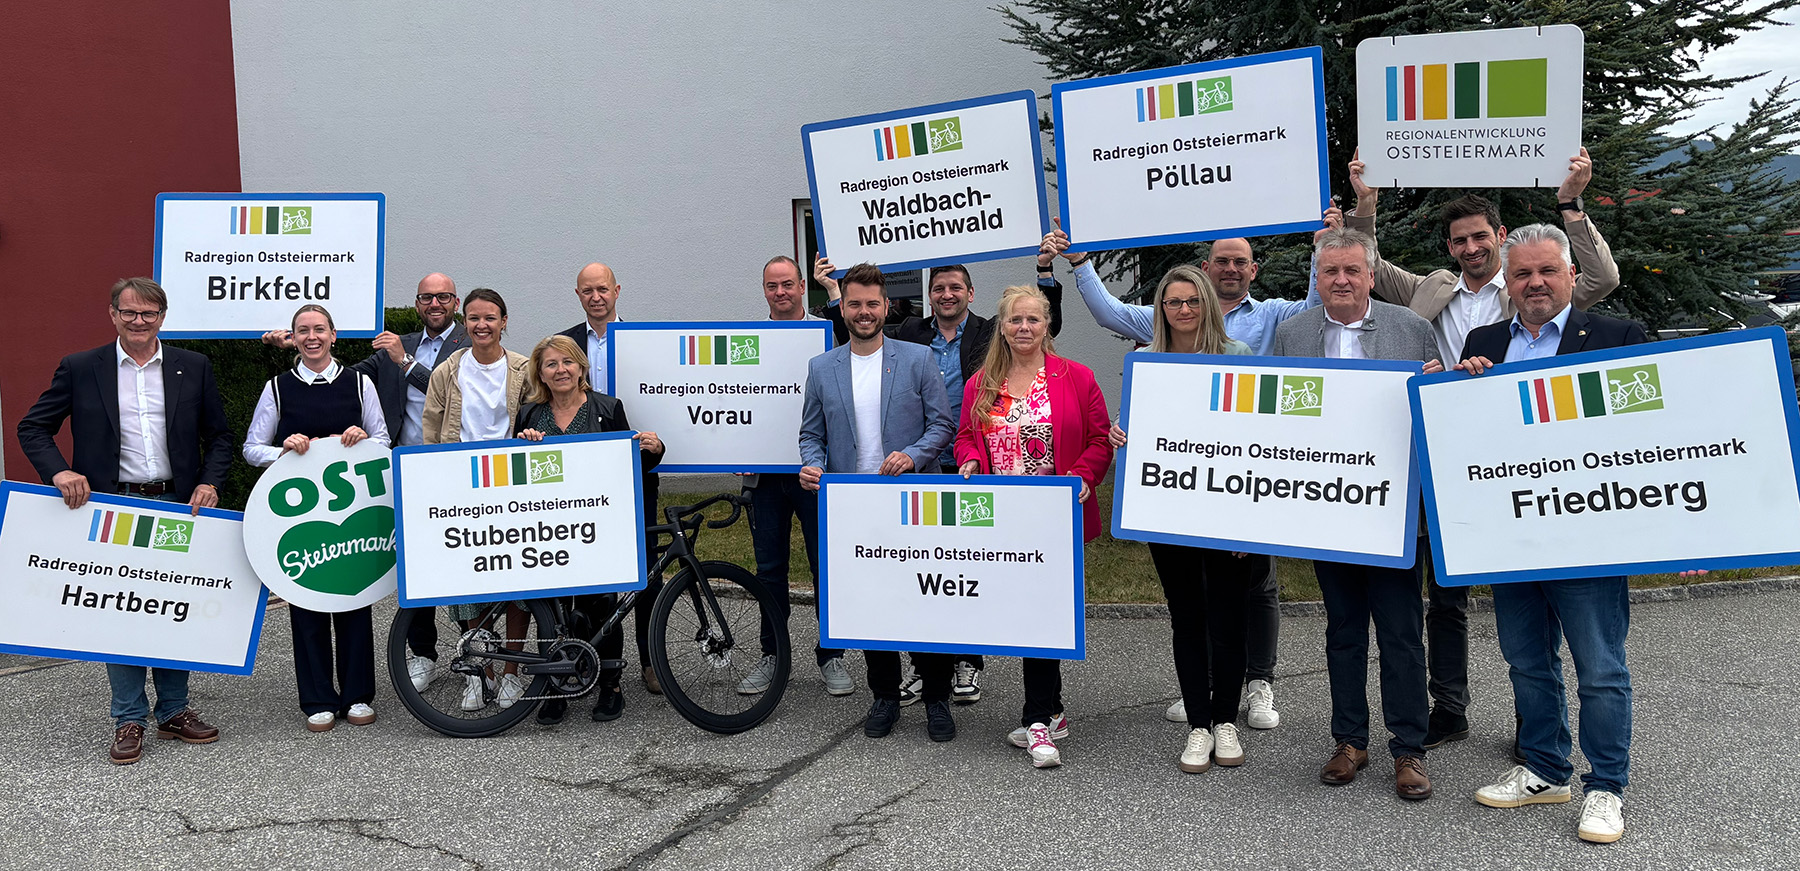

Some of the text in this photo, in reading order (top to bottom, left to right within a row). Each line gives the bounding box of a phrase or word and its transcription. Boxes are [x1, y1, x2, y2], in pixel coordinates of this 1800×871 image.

[1093, 126, 1286, 161] Radregion Oststeiermark
[1387, 127, 1545, 140] REGIONALENTWICKLUNG
[1387, 144, 1544, 159] OSTSTEIERMARK
[840, 160, 1009, 194] Radregion Oststeiermark
[1147, 164, 1231, 190] Pöllau
[862, 186, 991, 220] Waldbach-
[858, 207, 1003, 246] Mönichwald
[185, 252, 354, 265] Radregion Oststeiermark
[208, 276, 330, 300] Birkfeld
[640, 383, 801, 397] Radregion Oststeiermark
[687, 406, 751, 424] Vorau
[1156, 438, 1375, 466] Radregion Oststeiermark
[1468, 438, 1747, 480] Radregion Oststeiermark
[268, 457, 390, 517] OST
[1141, 463, 1390, 506] Bad Loipersdorf
[429, 495, 609, 518] Radregion Oststeiermark
[1511, 480, 1708, 518] Friedberg
[444, 521, 596, 549] Stubenberg
[474, 547, 569, 572] am See
[856, 545, 1043, 563] Radregion Oststeiermark
[28, 555, 232, 589] Radregion Oststeiermark
[917, 573, 978, 597] Weiz
[61, 584, 190, 622] Hartberg
